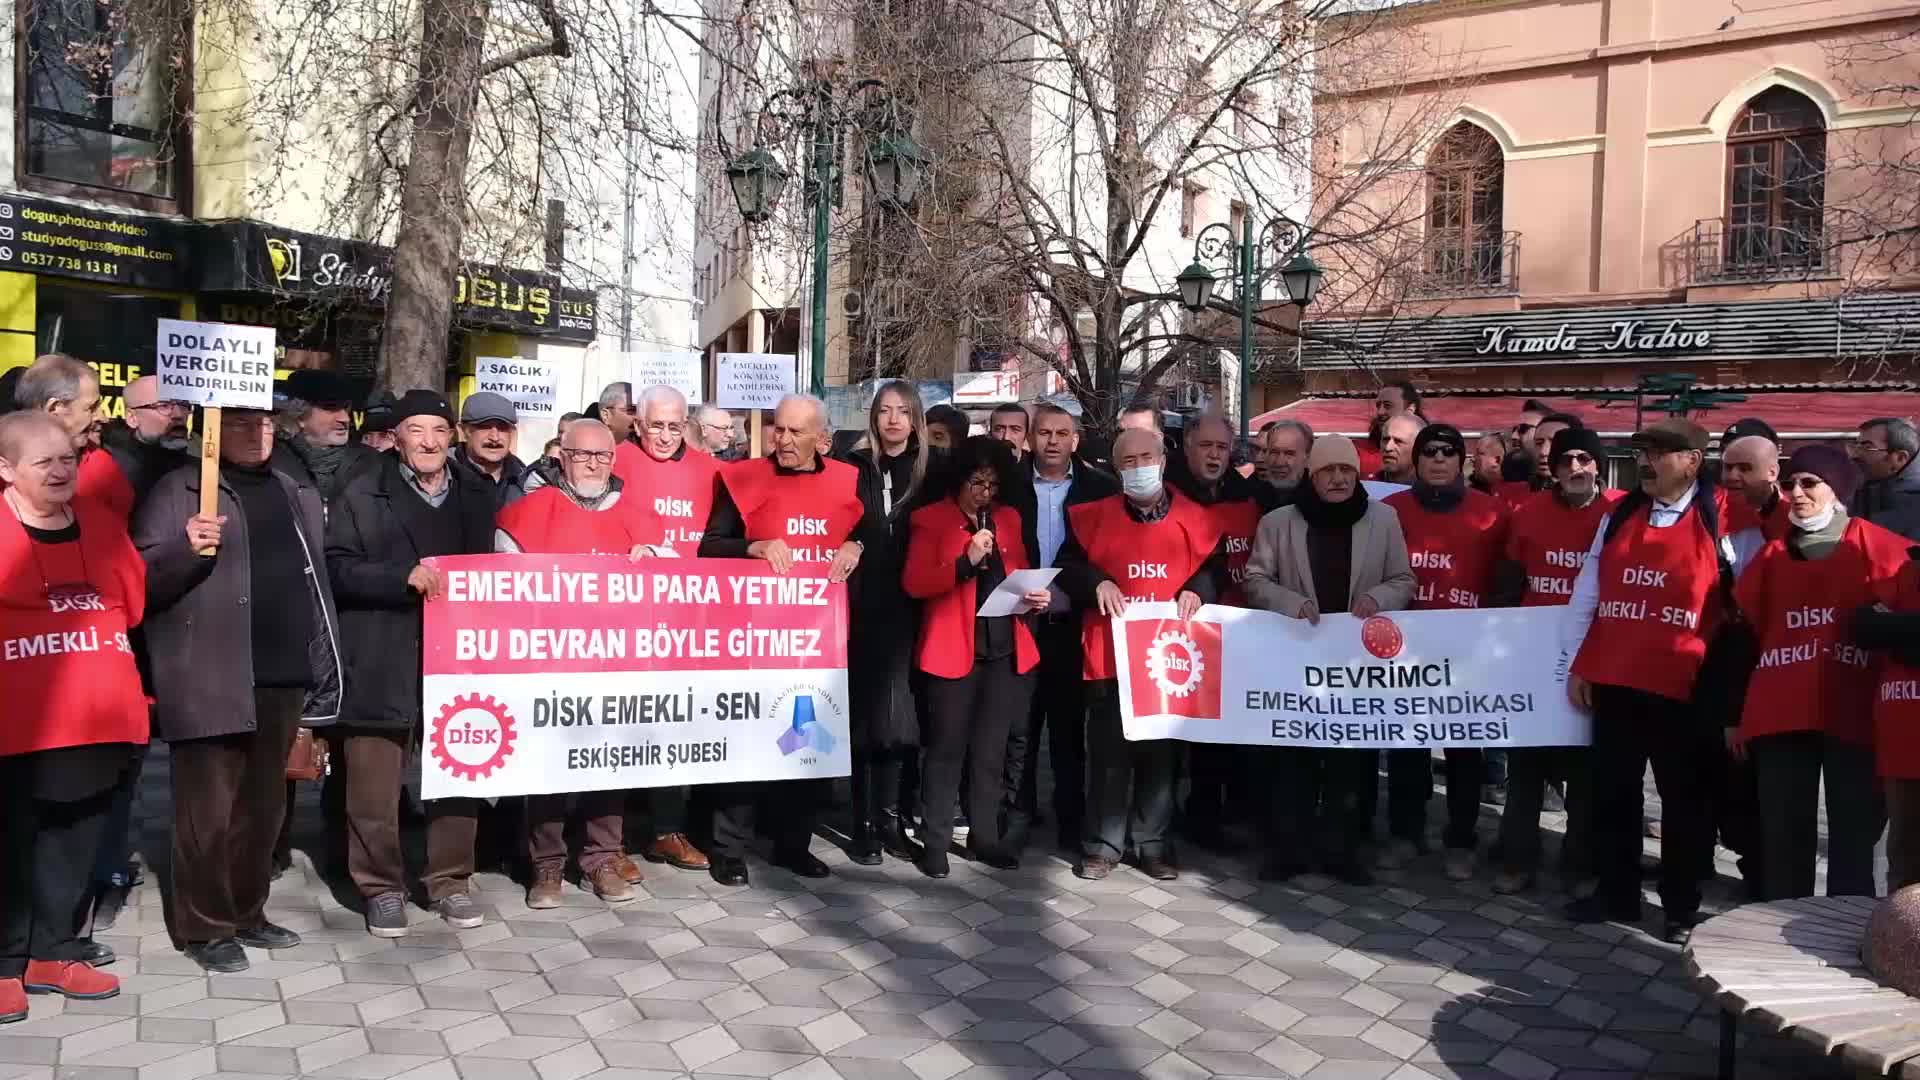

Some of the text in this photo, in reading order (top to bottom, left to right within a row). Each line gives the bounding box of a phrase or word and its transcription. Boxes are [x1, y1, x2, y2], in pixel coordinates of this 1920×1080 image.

[22, 207, 148, 237] dogusphotoandvideo
[22, 231, 173, 261] studyodoguss@gmail.com
[22, 252, 118, 275] 0537 738 13 81
[168, 333, 262, 356] DOLAYLI
[1476, 319, 1711, 354] Kumda Kahve
[160, 353, 270, 377] VERGİLER
[162, 374, 266, 393] KALDIRILSIN
[480, 382, 550, 395] KATKI PAYI
[512, 401, 553, 413] RILSIN
[654, 495, 694, 518] DİSK
[787, 514, 828, 536] DİSK
[1128, 560, 1168, 580] DİSK
[1410, 550, 1453, 569] DİSK
[448, 565, 829, 606] EMEKLİYE BU PARA YETMEZ
[1528, 575, 1573, 595] MEKL
[1622, 566, 1668, 588] DİSK
[1449, 587, 1480, 608] SEN
[1660, 605, 1697, 629] SEN
[1786, 606, 1835, 629] DİSK
[3, 626, 99, 661] EMEKLİ
[456, 623, 822, 661] BU DEVRAN BÖYLE GİTMEZ
[1755, 638, 1819, 669] MEKLİ
[1305, 659, 1452, 689] DEVRİMCİ
[533, 690, 594, 728] DİSK
[602, 686, 693, 725] EMEKLİ
[715, 692, 760, 721] SEN
[1245, 690, 1534, 716] EMEKLİLER SENDİKASI
[448, 722, 498, 744] DİSK
[1271, 717, 1509, 746] ESKİŞEHİR ŞUBESİ
[568, 737, 727, 772] ESKİŞEHİR ŞUBESİ
